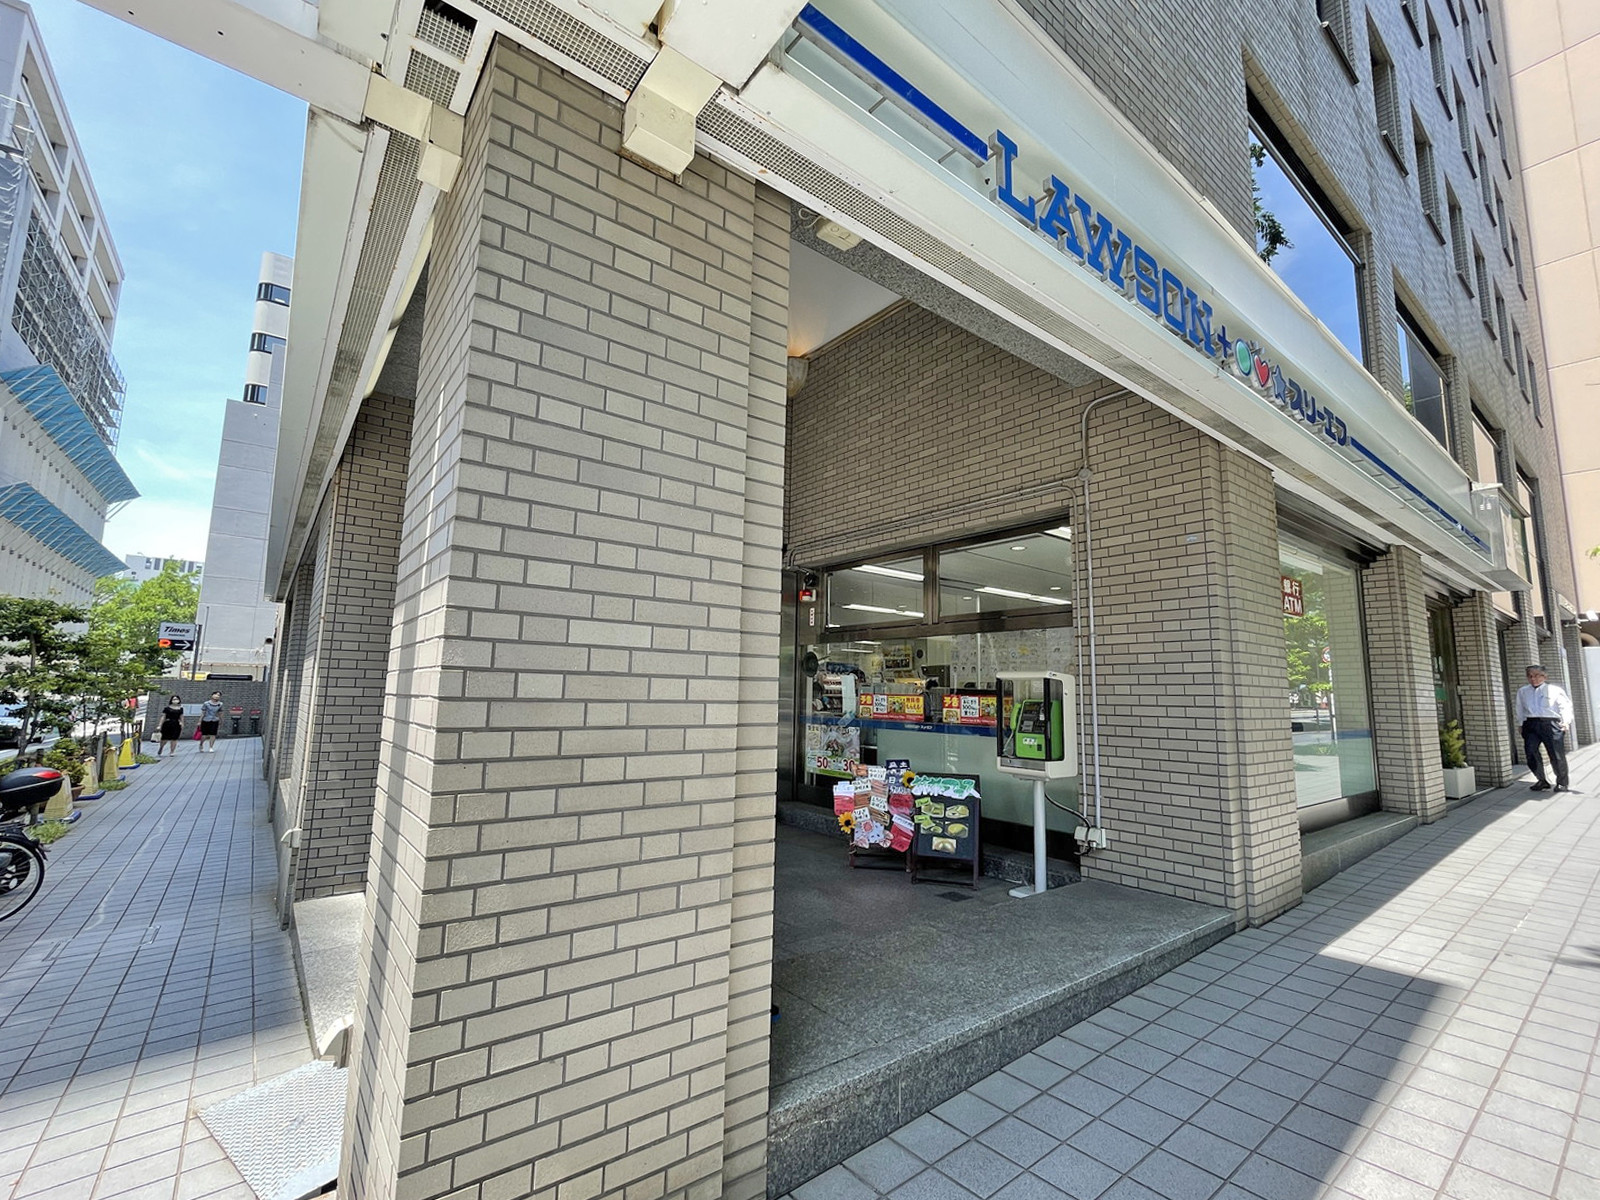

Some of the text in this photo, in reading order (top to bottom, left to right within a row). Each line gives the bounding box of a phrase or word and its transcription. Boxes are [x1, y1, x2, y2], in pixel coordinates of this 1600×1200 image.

[996, 129, 1216, 358] LAWSON
[1283, 596, 1303, 614] ATM
[816, 756, 829, 769] 50
